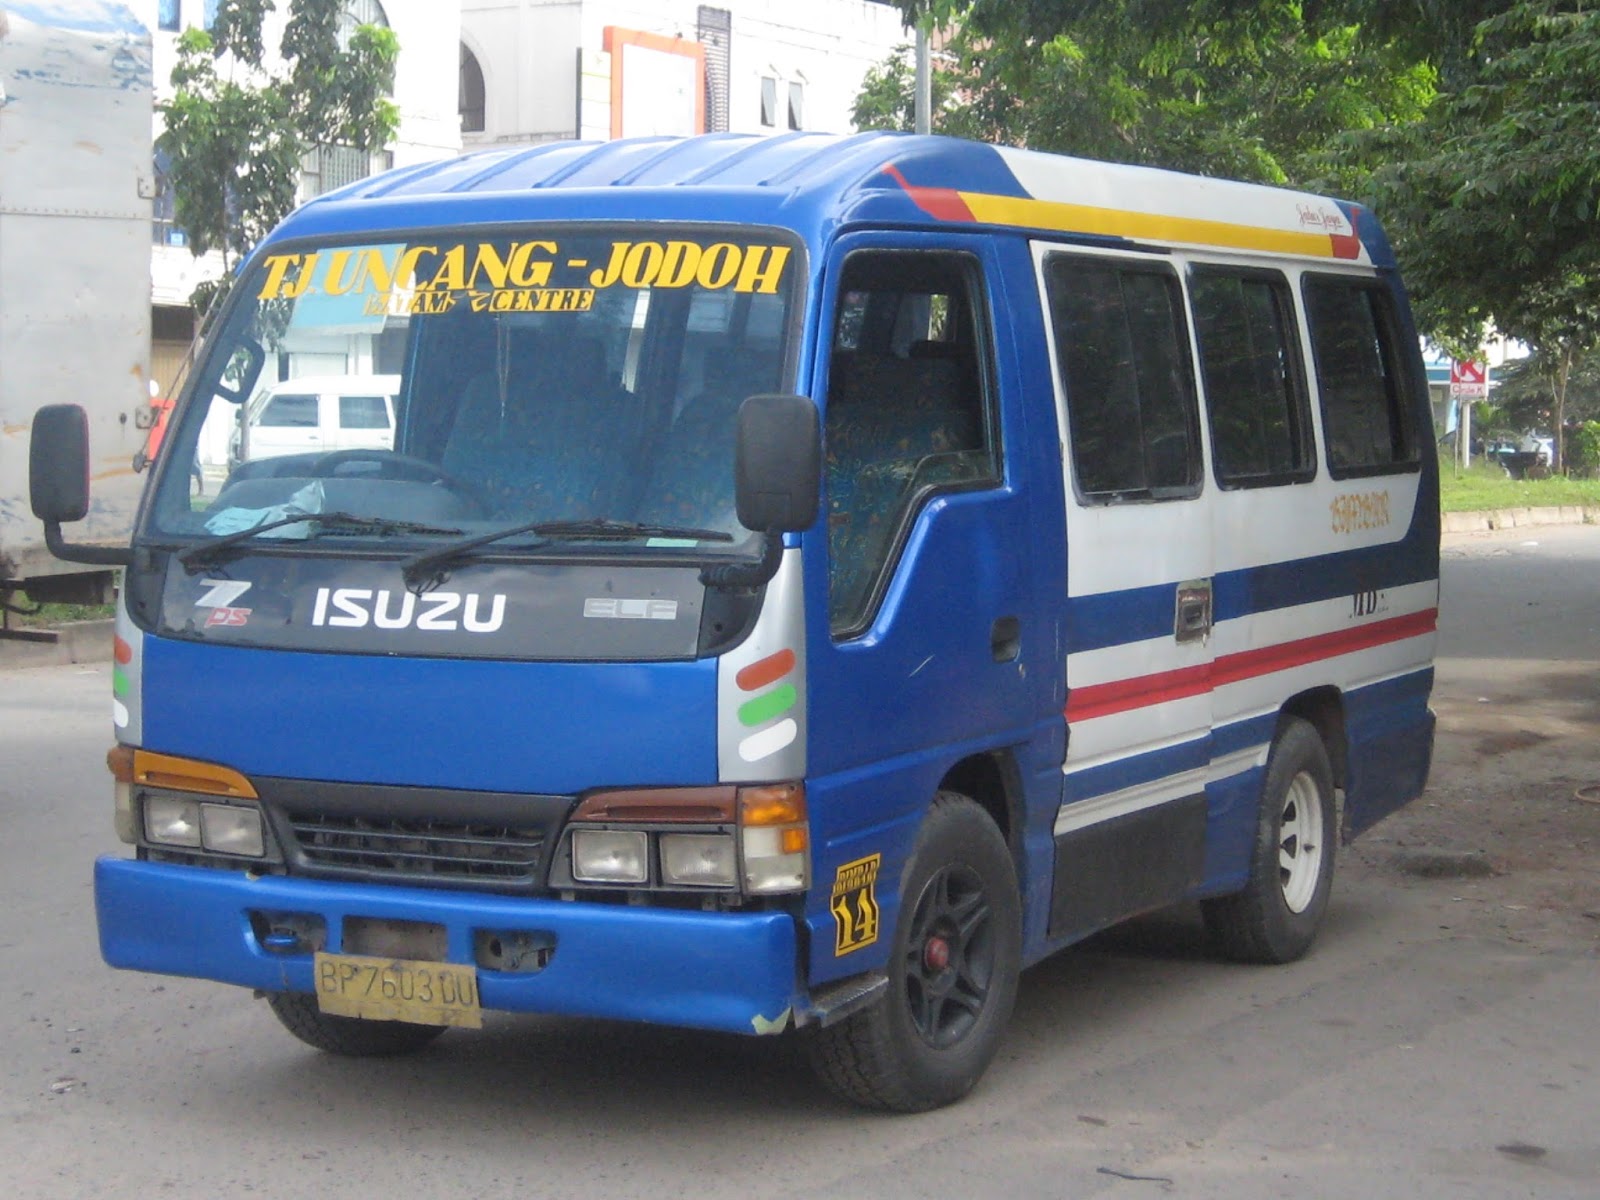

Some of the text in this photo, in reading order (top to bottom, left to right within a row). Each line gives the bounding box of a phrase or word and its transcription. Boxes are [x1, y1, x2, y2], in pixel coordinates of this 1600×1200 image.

[589, 240, 792, 294] JODOH
[364, 289, 593, 314] BATAM CENTRE
[194, 578, 252, 608] Z
[311, 587, 506, 633] ISUZU
[584, 598, 677, 619] ELF
[833, 887, 876, 949] 14
[320, 961, 354, 994] BP
[360, 964, 434, 1002] 7603
